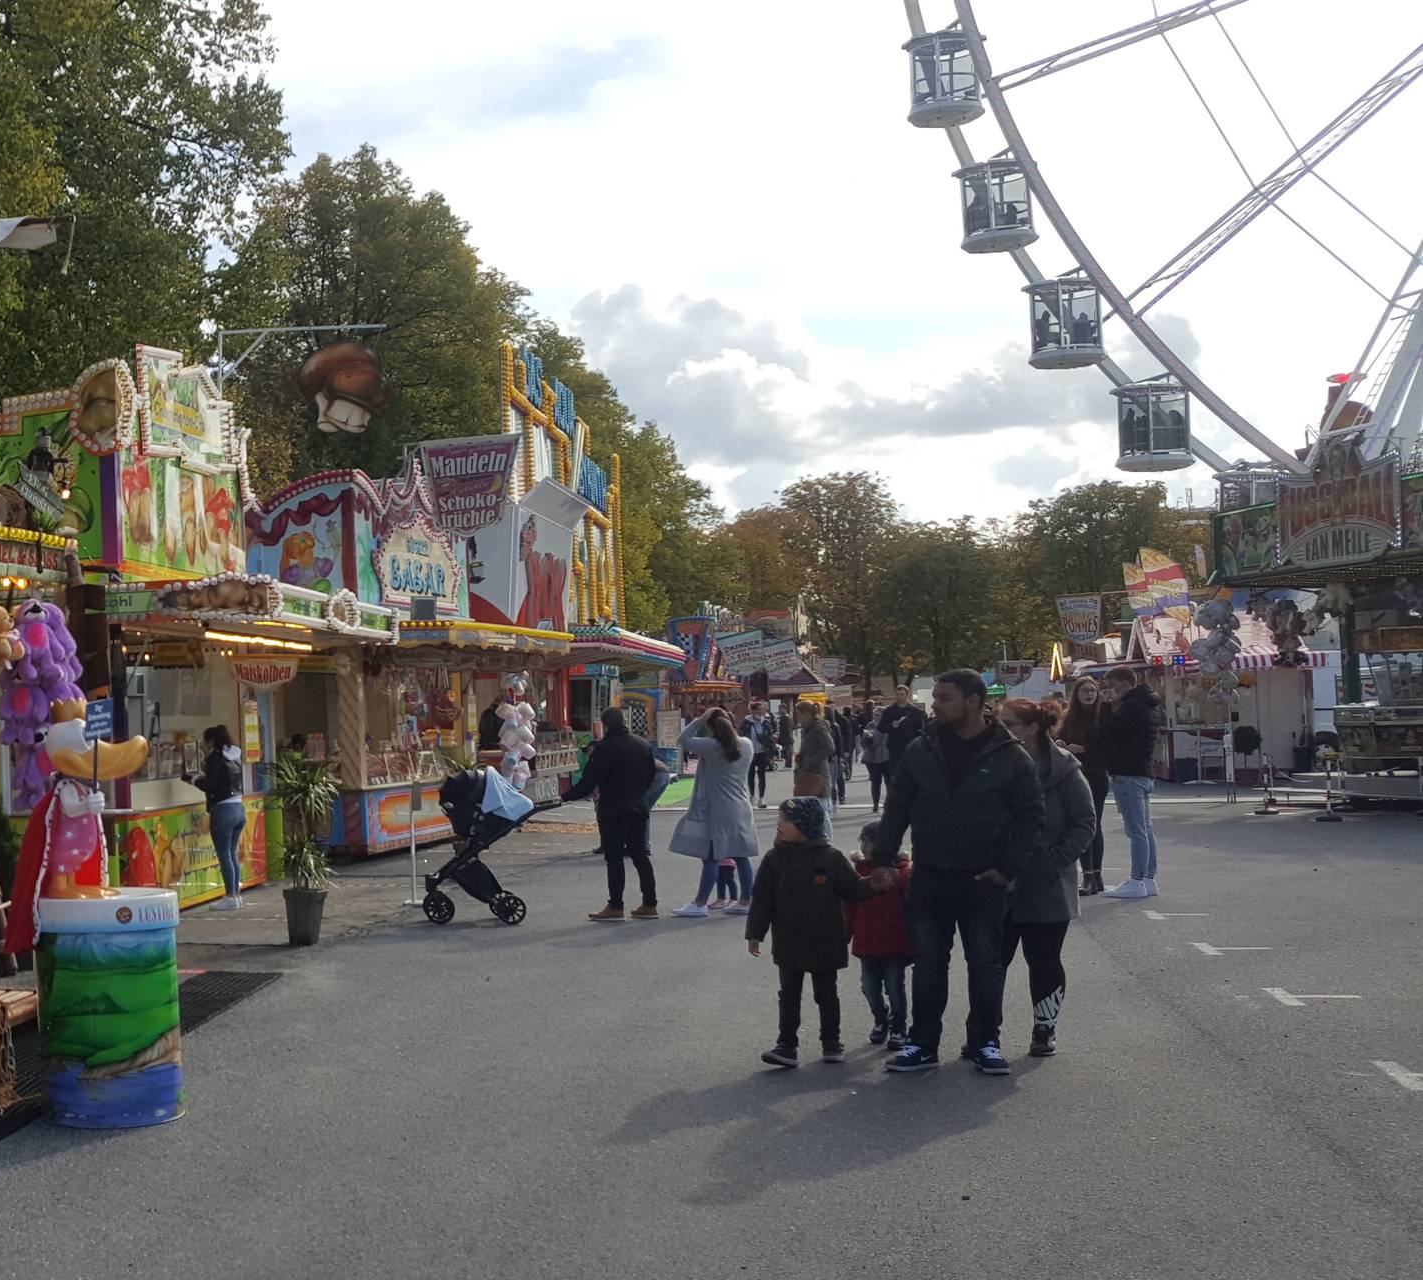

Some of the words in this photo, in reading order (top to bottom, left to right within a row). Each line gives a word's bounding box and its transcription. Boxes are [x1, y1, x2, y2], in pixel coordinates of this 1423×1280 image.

[430, 451, 507, 477] Mandeln
[440, 509, 496, 528] früchte
[1062, 615, 1098, 633] POMMES
[235, 664, 291, 684] Maiskolben
[1035, 985, 1064, 1019] NIKE
